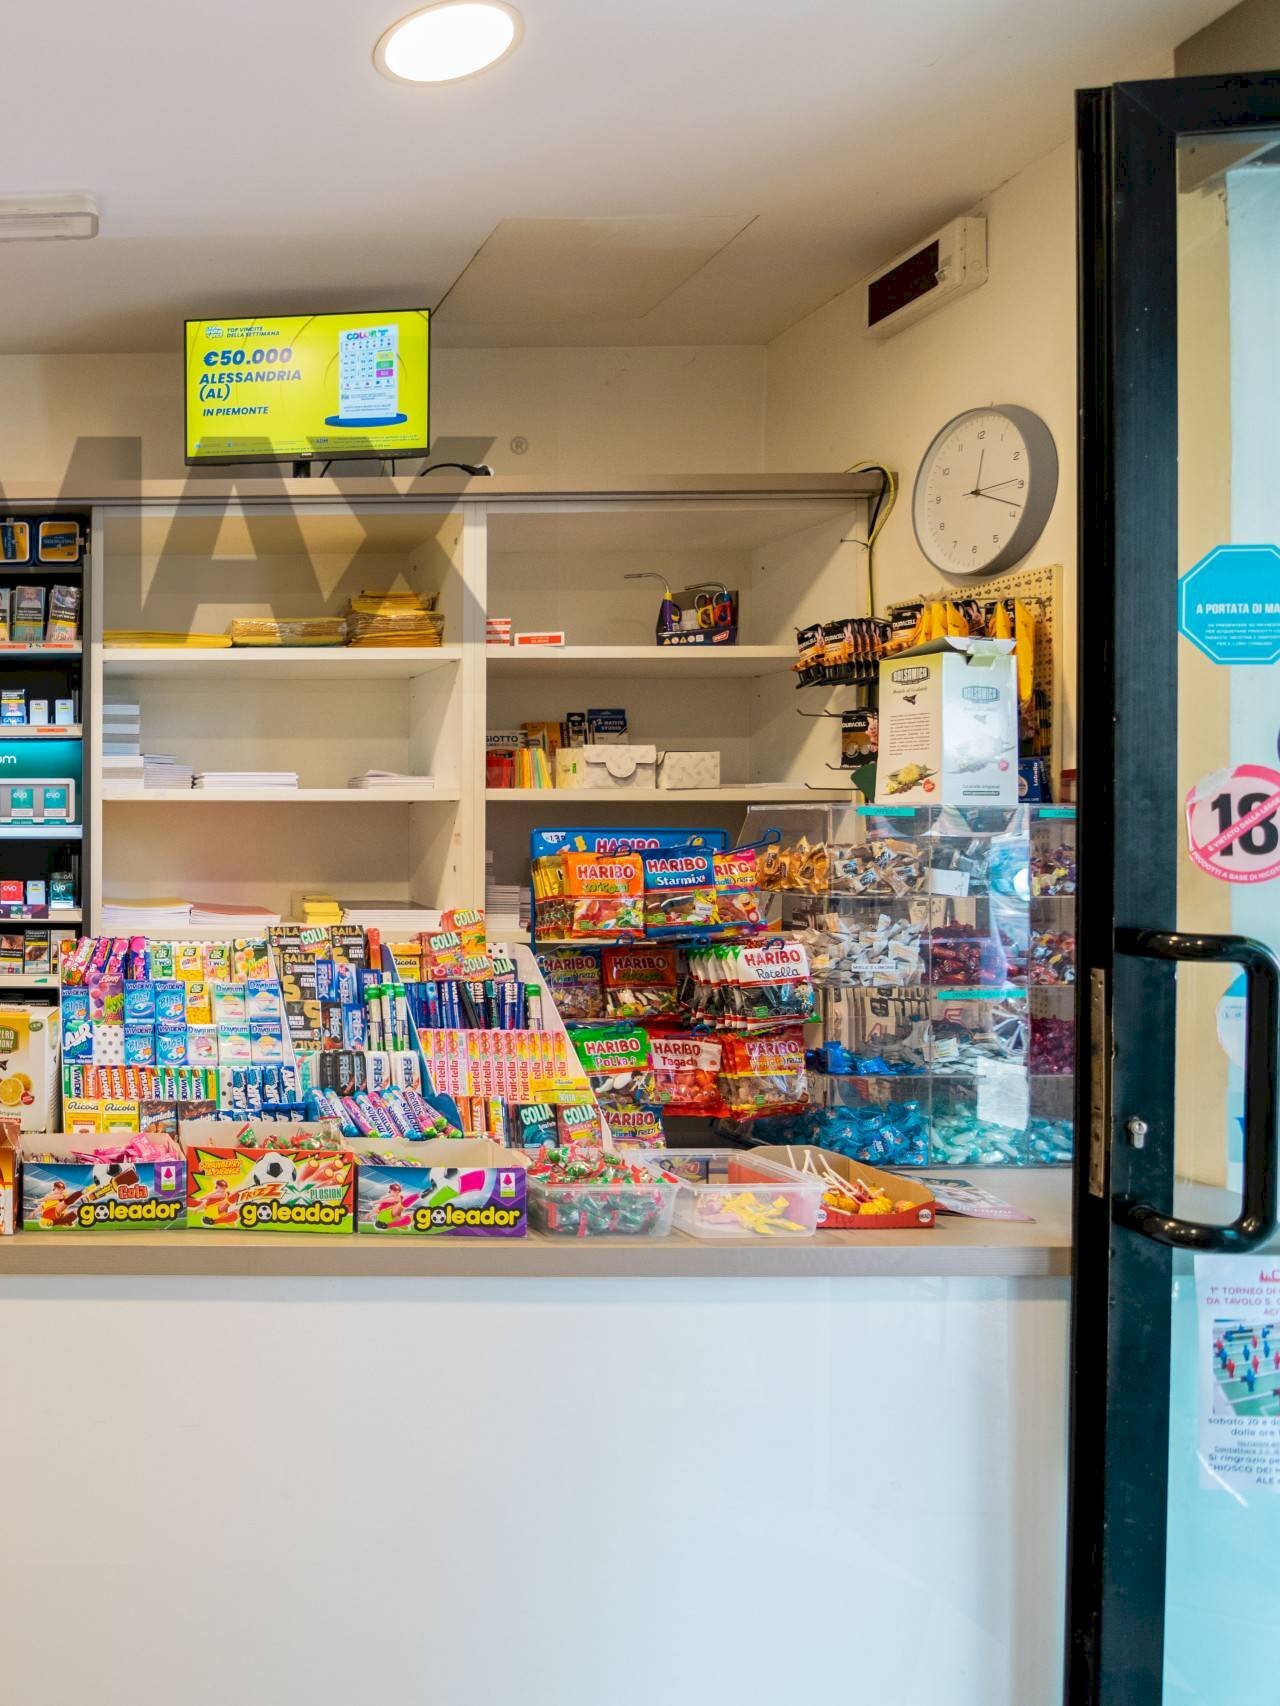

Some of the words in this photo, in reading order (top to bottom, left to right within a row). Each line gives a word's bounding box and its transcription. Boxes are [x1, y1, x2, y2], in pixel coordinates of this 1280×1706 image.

[203, 347, 292, 366] €50.000
[199, 369, 301, 385] ALESSANDRIA
[199, 384, 230, 402] (AL)
[203, 408, 214, 417] IN
[215, 406, 269, 416] PIEMONTE
[977, 430, 986, 440] 12
[1012, 451, 1020, 461] 2
[1017, 479, 1025, 489] 3
[935, 496, 941, 505] 9
[992, 534, 999, 544] 5
[971, 545, 977, 554] 6
[1195, 603, 1204, 615] A
[1205, 603, 1250, 615] PORTATA
[1252, 603, 1262, 615] DI
[892, 619, 916, 629] DURACELL
[1211, 793, 1278, 857] 18
[577, 864, 635, 880] HARIBO
[647, 856, 707, 873] HARIBO
[714, 863, 750, 876] RIBO
[656, 873, 705, 887] Starmix
[1228, 873, 1248, 881] BASE
[454, 912, 482, 926] GOLIA
[270, 928, 300, 936] SAILA
[301, 927, 329, 944] GOLIA
[332, 927, 363, 936] SAILA
[431, 934, 461, 951] GOLIA
[284, 954, 315, 963] SAILA
[544, 957, 596, 971] HARIBO
[612, 956, 668, 971] HARIBO
[745, 950, 801, 967] HARIBO
[585, 1038, 640, 1055] HARIBO
[653, 1042, 701, 1058] HARIBO
[746, 1040, 800, 1056] HARIBO
[373, 1058, 383, 1089] FRISK
[403, 1058, 413, 1089] FRISK
[105, 1103, 136, 1111] Ricola
[520, 1103, 555, 1126] GOLIA
[563, 1104, 597, 1126] GOLIA
[603, 1111, 655, 1126] HARIBO
[119, 1184, 147, 1200] Cola
[238, 1183, 284, 1202] FRIZZ
[80, 1200, 181, 1226] goleador
[241, 1202, 346, 1226] goleador
[416, 1207, 520, 1230] goleador
[1223, 1286, 1264, 1296] TORNEO
[1206, 1297, 1220, 1305] DA
[1224, 1297, 1262, 1306] TAVOLO
